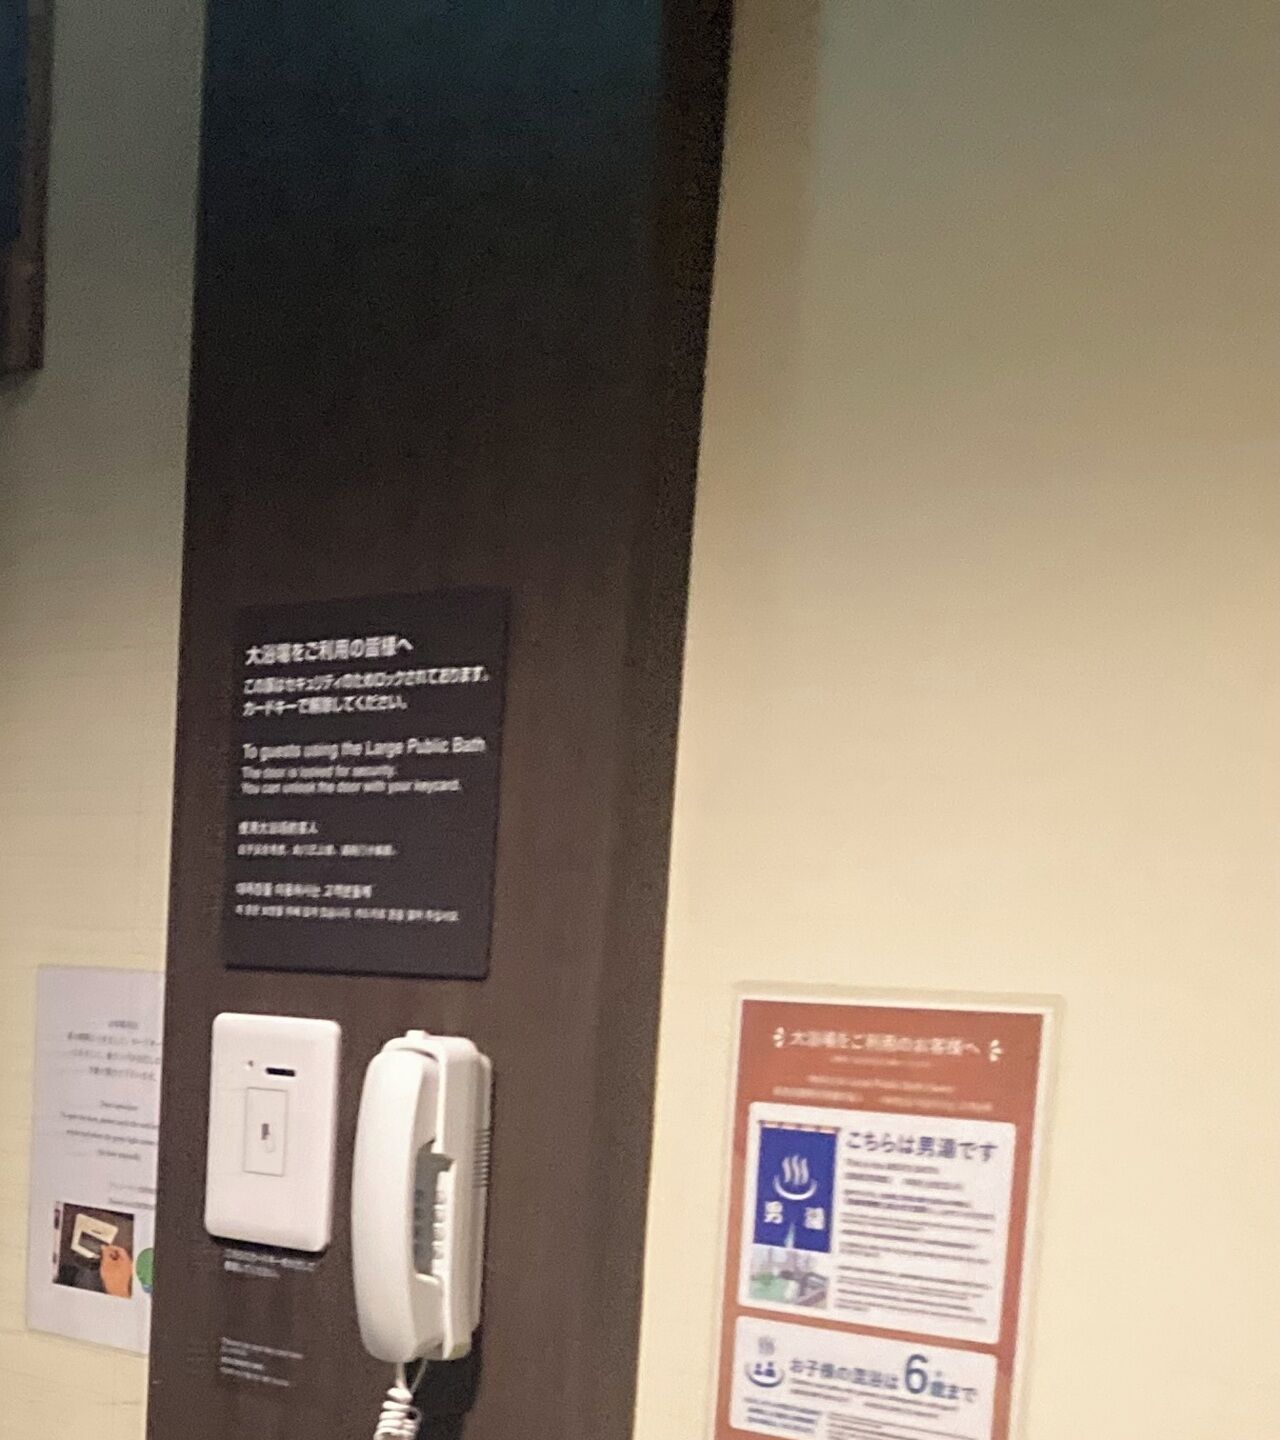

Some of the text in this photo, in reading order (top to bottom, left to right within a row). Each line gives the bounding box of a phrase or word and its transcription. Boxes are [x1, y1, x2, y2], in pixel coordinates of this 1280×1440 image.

[243, 743, 258, 759] To
[365, 740, 404, 759] Large
[407, 737, 449, 755] Public
[452, 736, 486, 754] Bath
